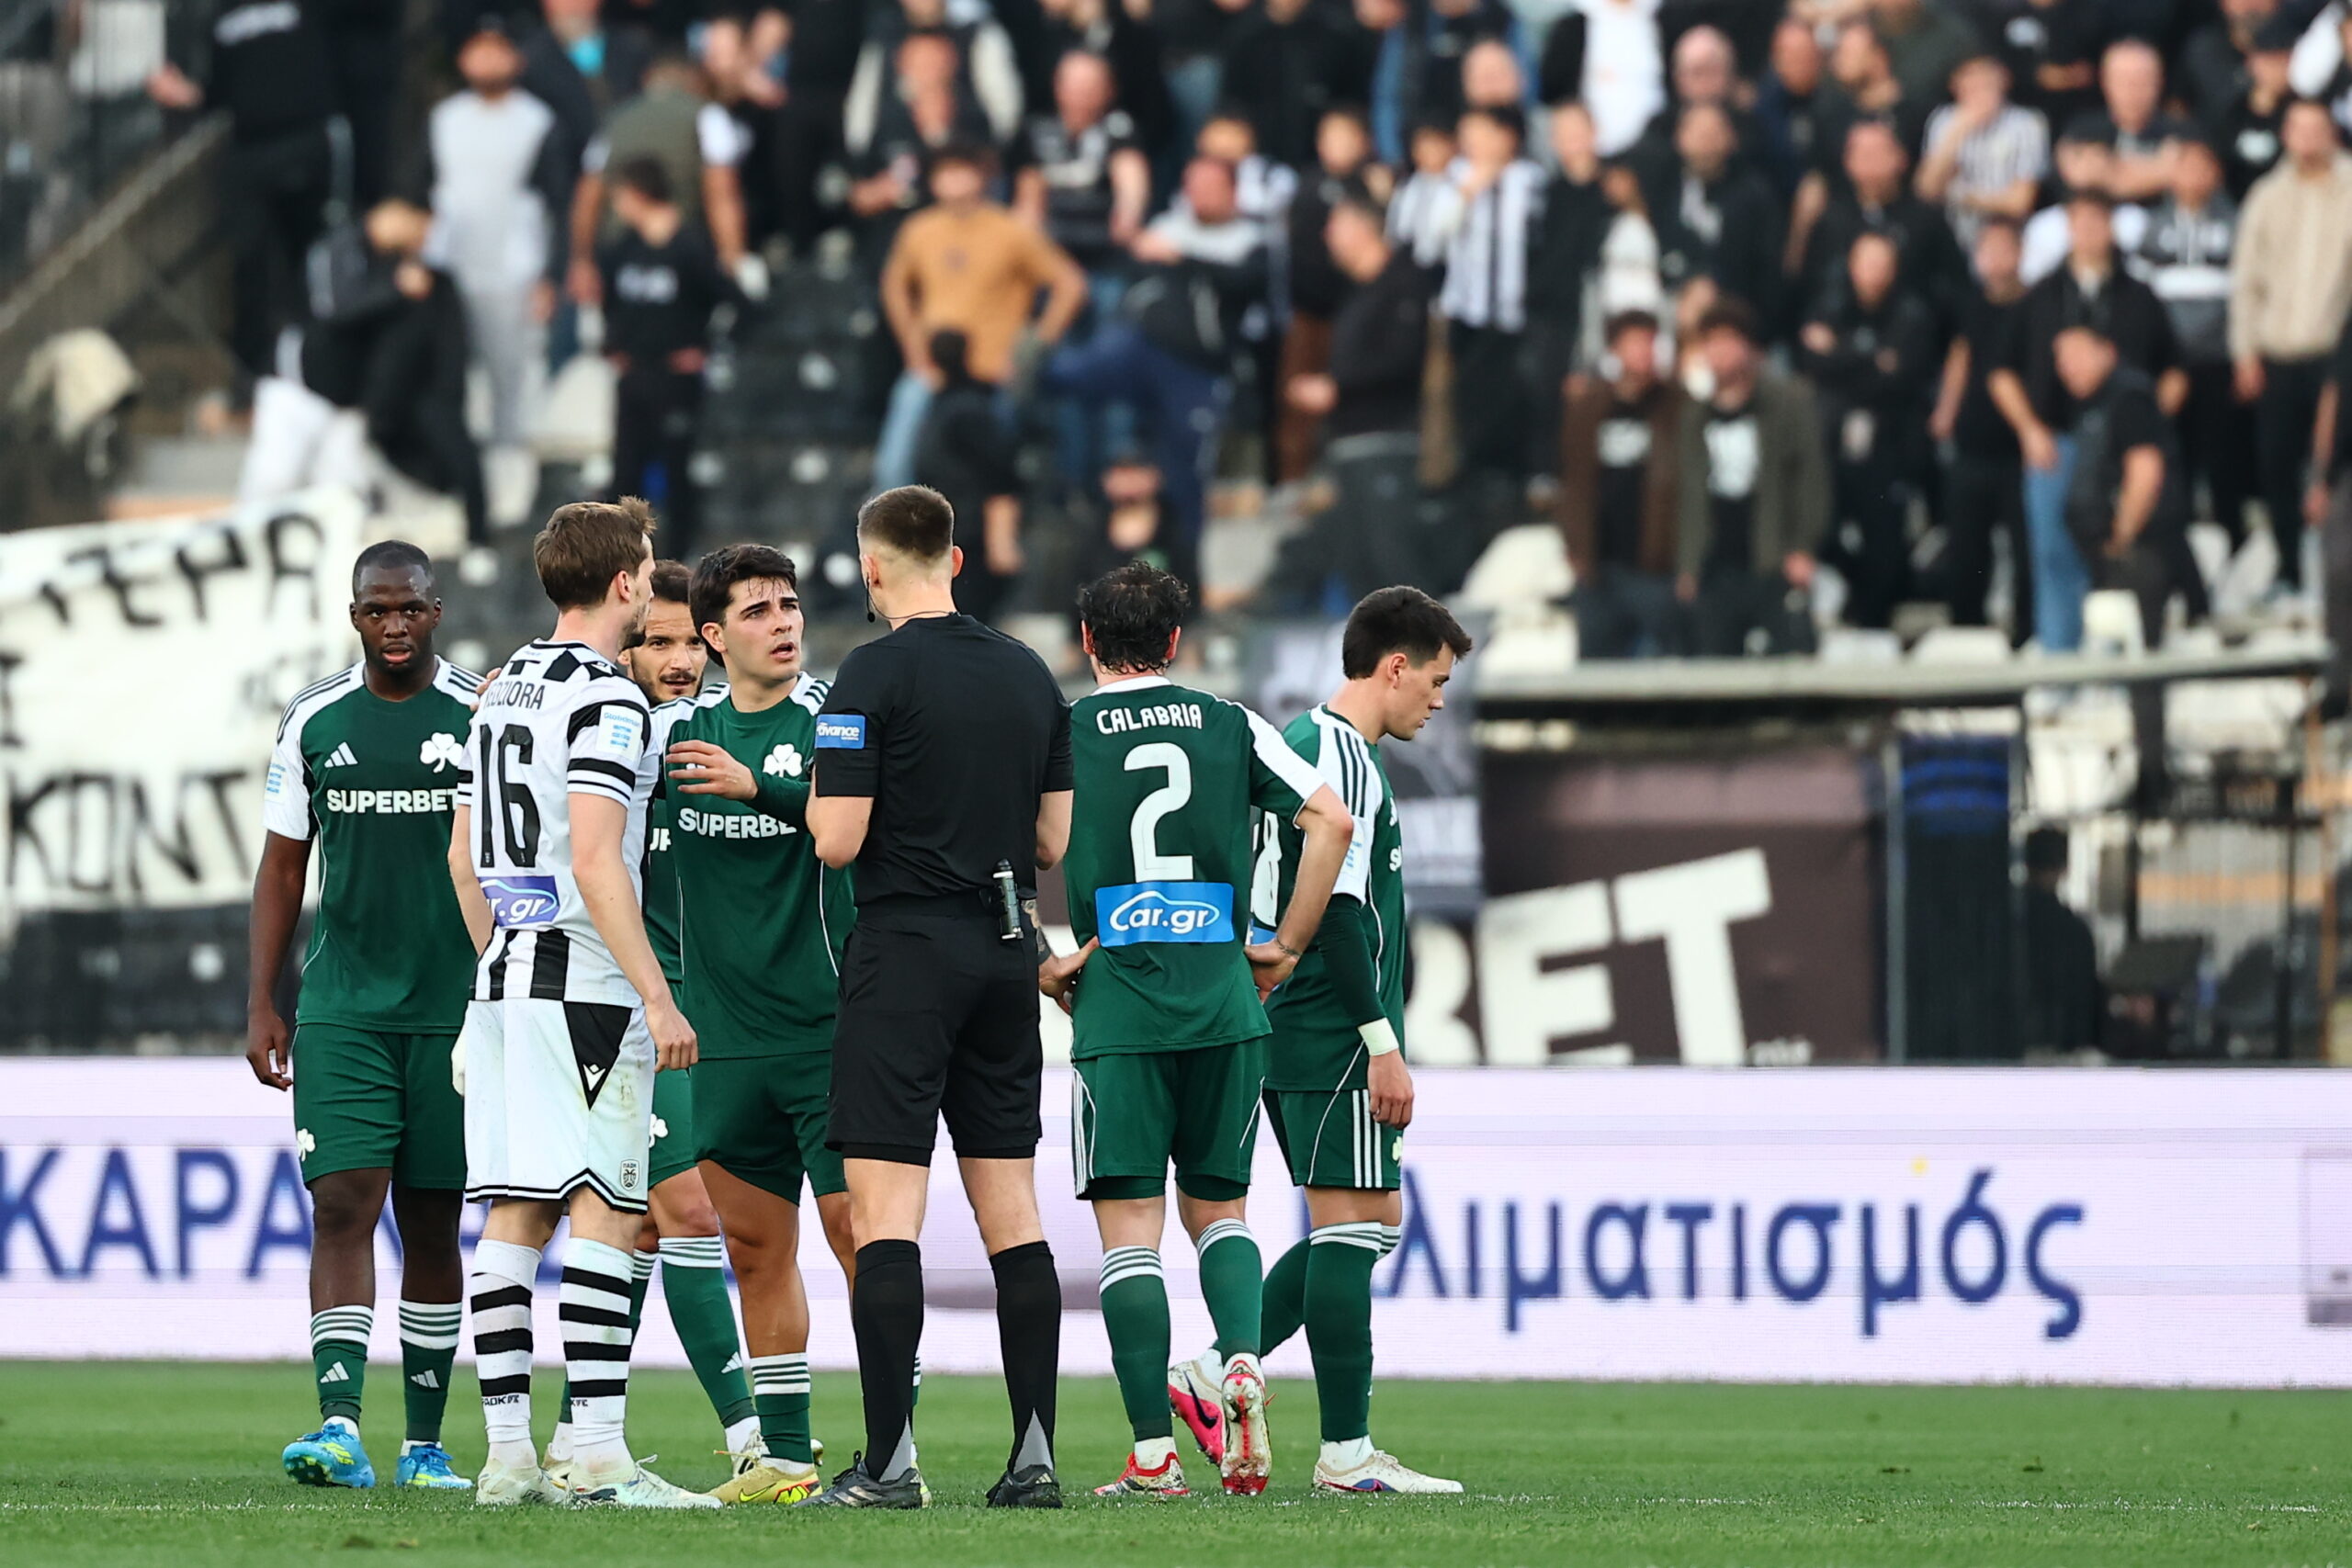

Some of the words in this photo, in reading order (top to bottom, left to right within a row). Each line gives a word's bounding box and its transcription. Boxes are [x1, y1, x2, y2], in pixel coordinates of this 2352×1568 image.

[483, 681, 546, 711] EDZIORA
[1096, 704, 1203, 735] CALABRIA
[480, 723, 541, 868] 16
[678, 807, 797, 839] SUPERBE
[1124, 742, 1193, 883] 2
[1297, 1165, 2086, 1339] λιματισμός
